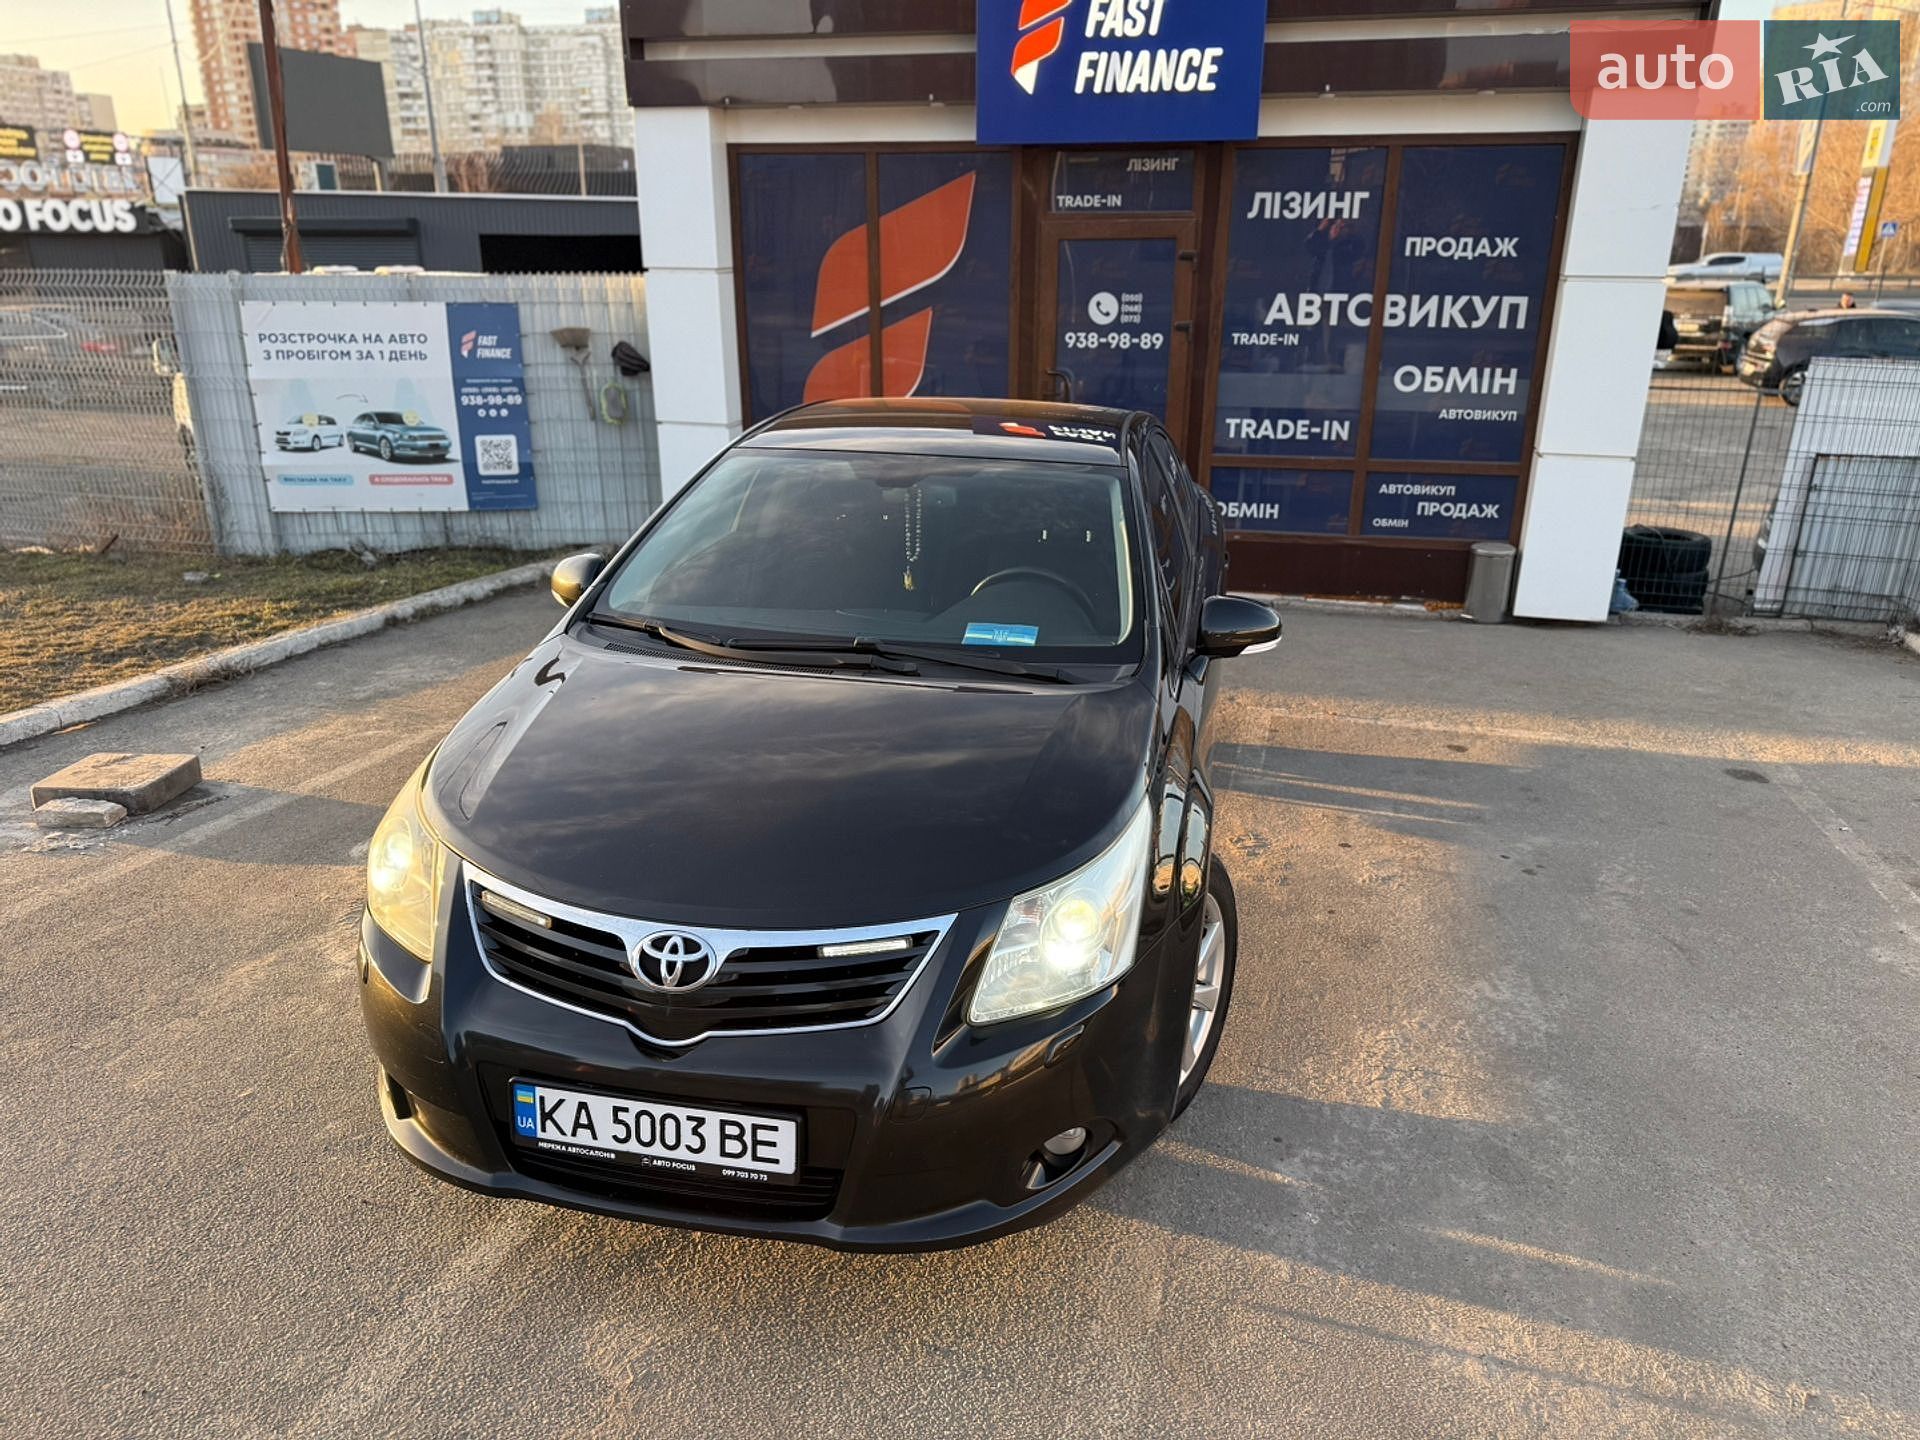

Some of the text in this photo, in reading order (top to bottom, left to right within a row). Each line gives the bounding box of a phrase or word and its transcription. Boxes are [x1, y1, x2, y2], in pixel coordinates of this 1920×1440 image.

[1085, 0, 1165, 38] FAST
[1074, 47, 1224, 94] FINANCE
[1126, 157, 1180, 172] ЛІЗИНГ
[1056, 194, 1122, 208] TRADE-IN
[1247, 191, 1370, 220] ЛІЗИНГ
[23, 198, 137, 233] FOCUS
[1404, 236, 1519, 260] ПРОДАЖ
[258, 333, 428, 344] РОЗСТРОЧКА НА АВТО
[477, 335, 498, 346] FAST
[1064, 332, 1164, 350] 938-98-89
[1232, 333, 1299, 346] TRADE-IN
[276, 350, 352, 361] ПРОБІГОМ
[356, 350, 375, 361] ЗА
[379, 350, 385, 361] 1
[388, 350, 428, 363] ДЕНЬ
[476, 348, 512, 359] FINANCE
[1393, 365, 1518, 395] ОБМІН
[460, 394, 523, 406] 938-98-89
[1438, 408, 1518, 422] АВТОВИКУП
[1225, 418, 1350, 441] TRADE-IN
[1379, 483, 1456, 496] АВТОВИКУП
[1416, 501, 1499, 519] ПРОДАЖ
[1372, 518, 1409, 528] ОБМІН
[517, 1115, 535, 1129] UA
[538, 1095, 780, 1165] KA 5003 BE
[672, 1161, 696, 1171] FOCUS
